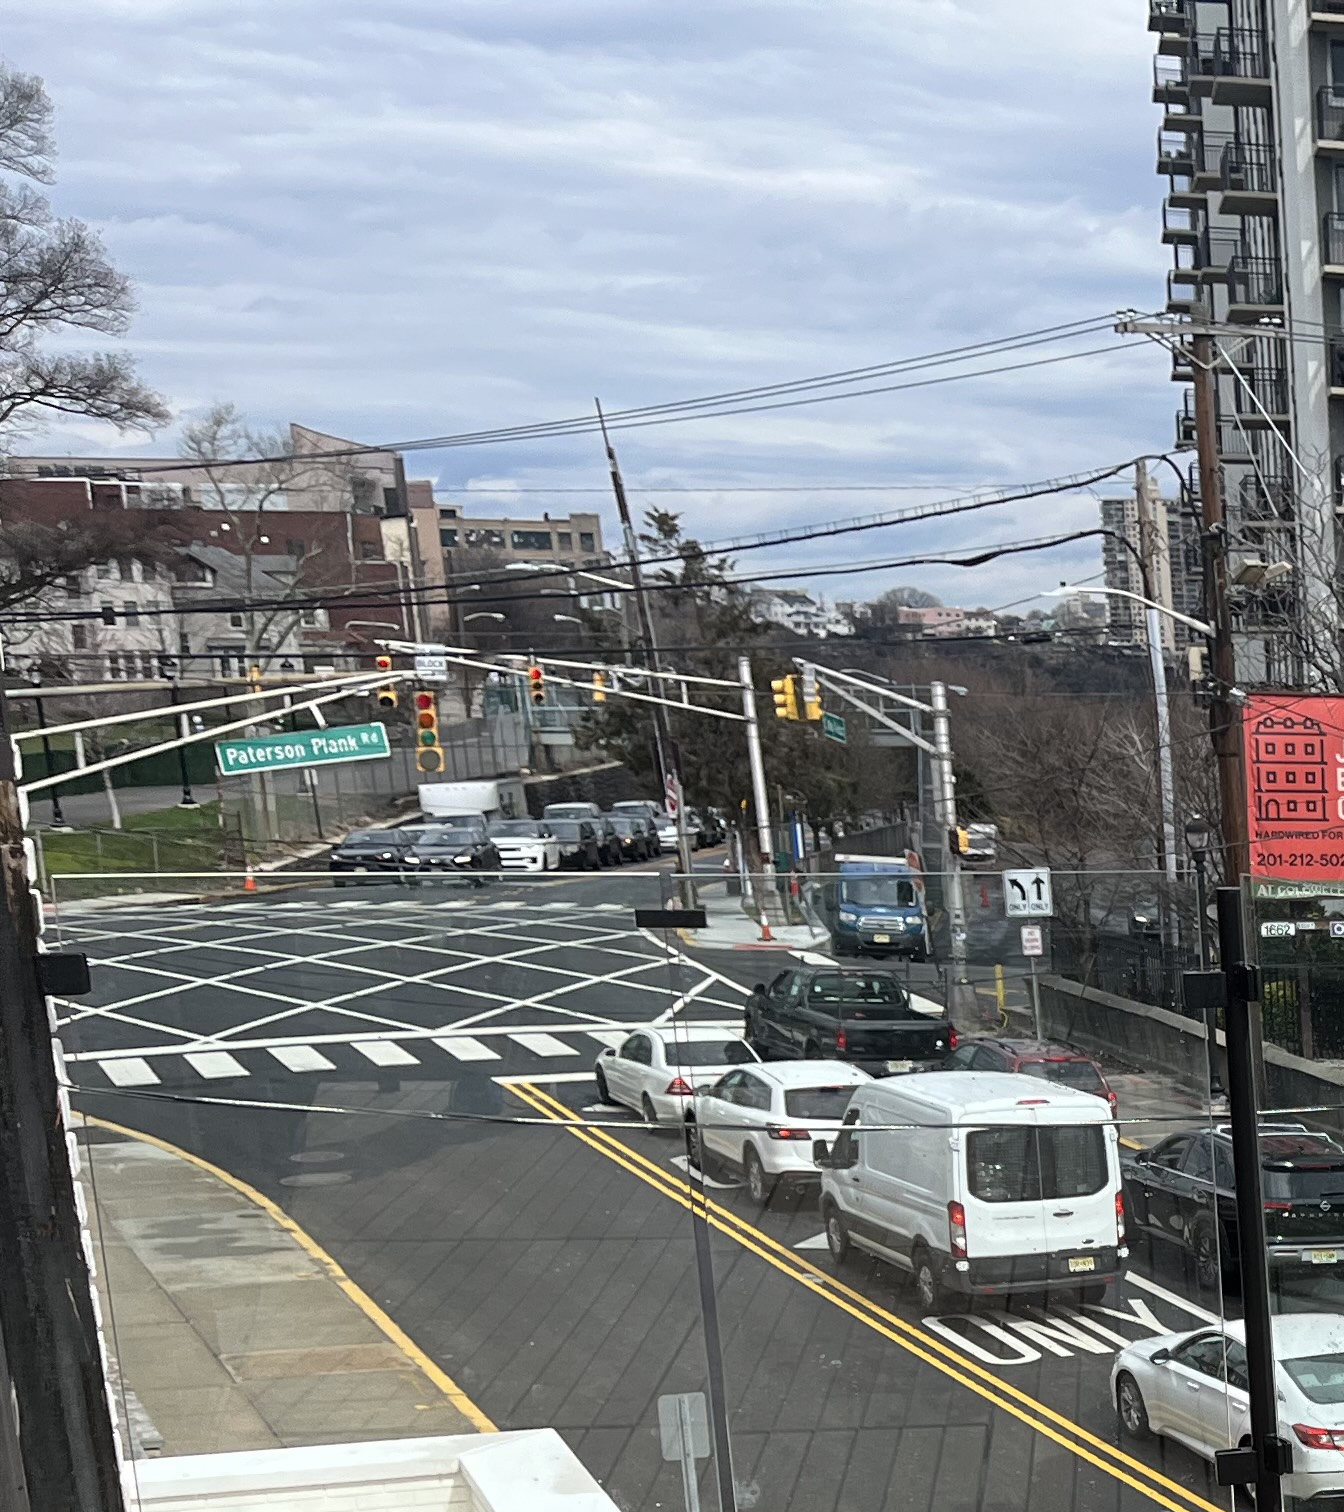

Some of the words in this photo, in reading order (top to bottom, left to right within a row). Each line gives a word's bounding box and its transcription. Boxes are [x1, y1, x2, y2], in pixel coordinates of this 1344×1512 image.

[226, 745, 305, 766] Paterson
[311, 735, 359, 756] Plank
[361, 731, 379, 744] Rd
[1255, 831, 1320, 841] HARDWIRED
[1322, 830, 1343, 840] FOR
[1257, 884, 1275, 896] AT
[1008, 903, 1027, 911] ONLY
[1030, 903, 1049, 911] ONLY
[1264, 925, 1291, 936] 1662
